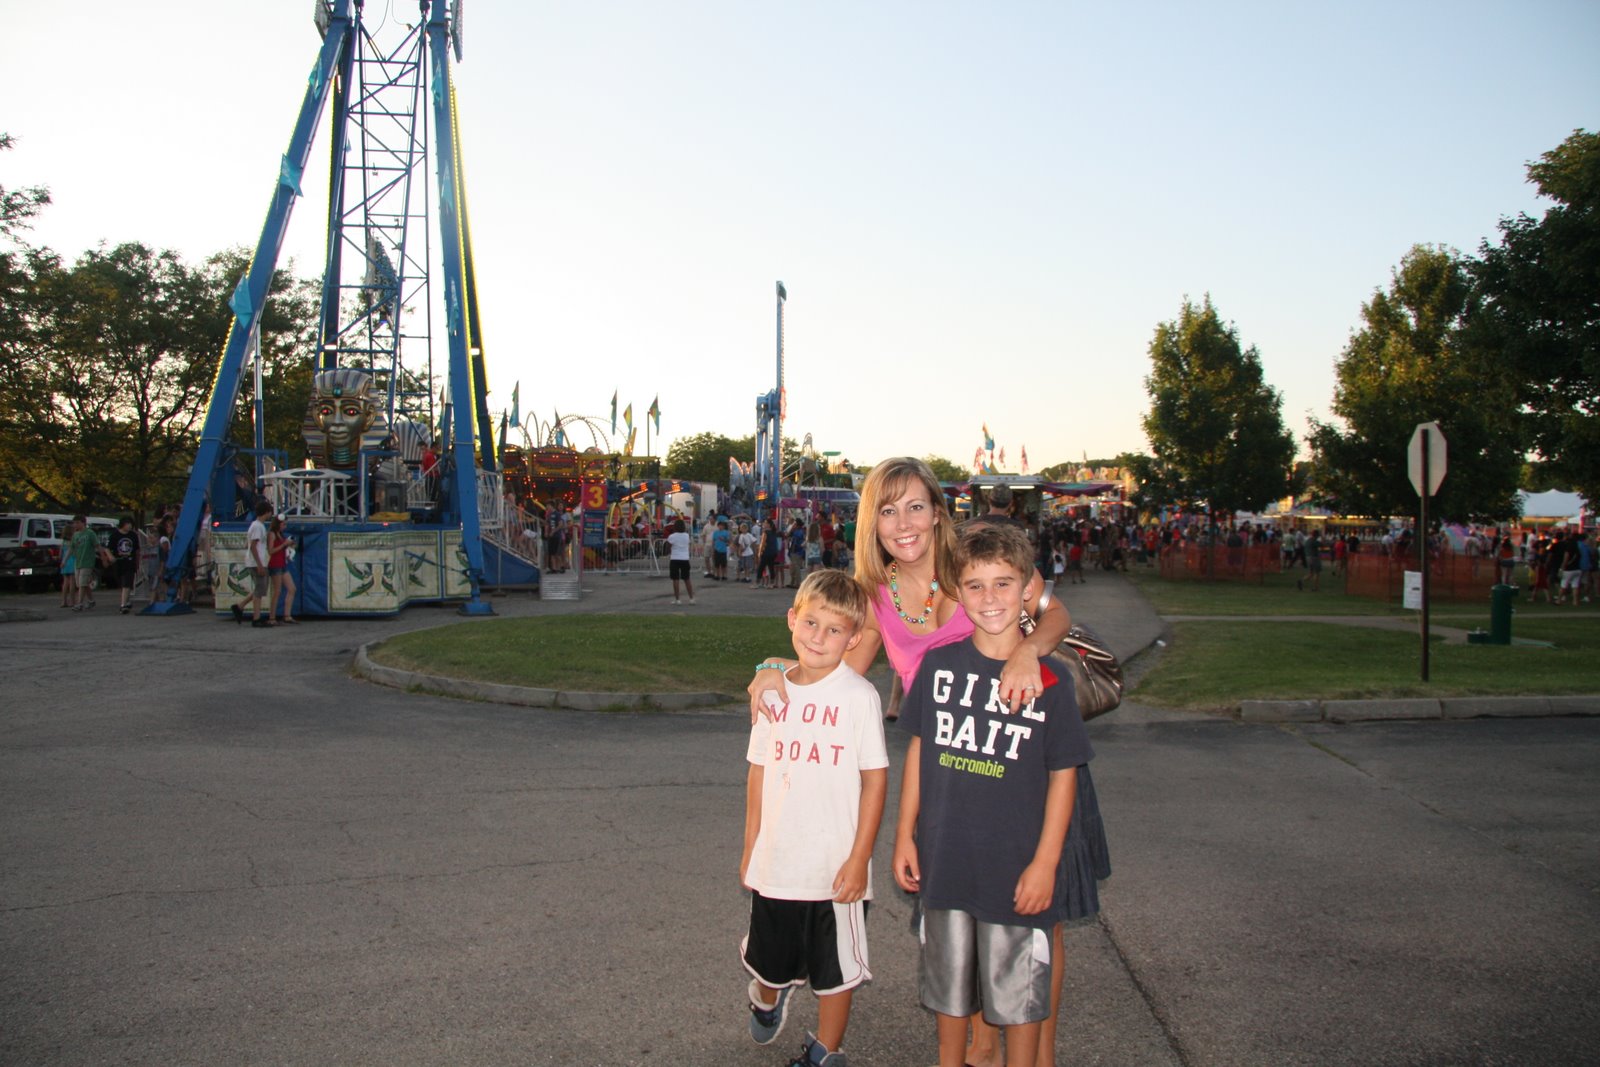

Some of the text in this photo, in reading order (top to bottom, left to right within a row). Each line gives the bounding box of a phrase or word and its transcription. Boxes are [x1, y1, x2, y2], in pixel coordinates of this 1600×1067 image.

[588, 486, 603, 508] 3
[802, 703, 839, 727] ON
[935, 710, 1032, 760] BAIT
[775, 740, 845, 766] BOAT
